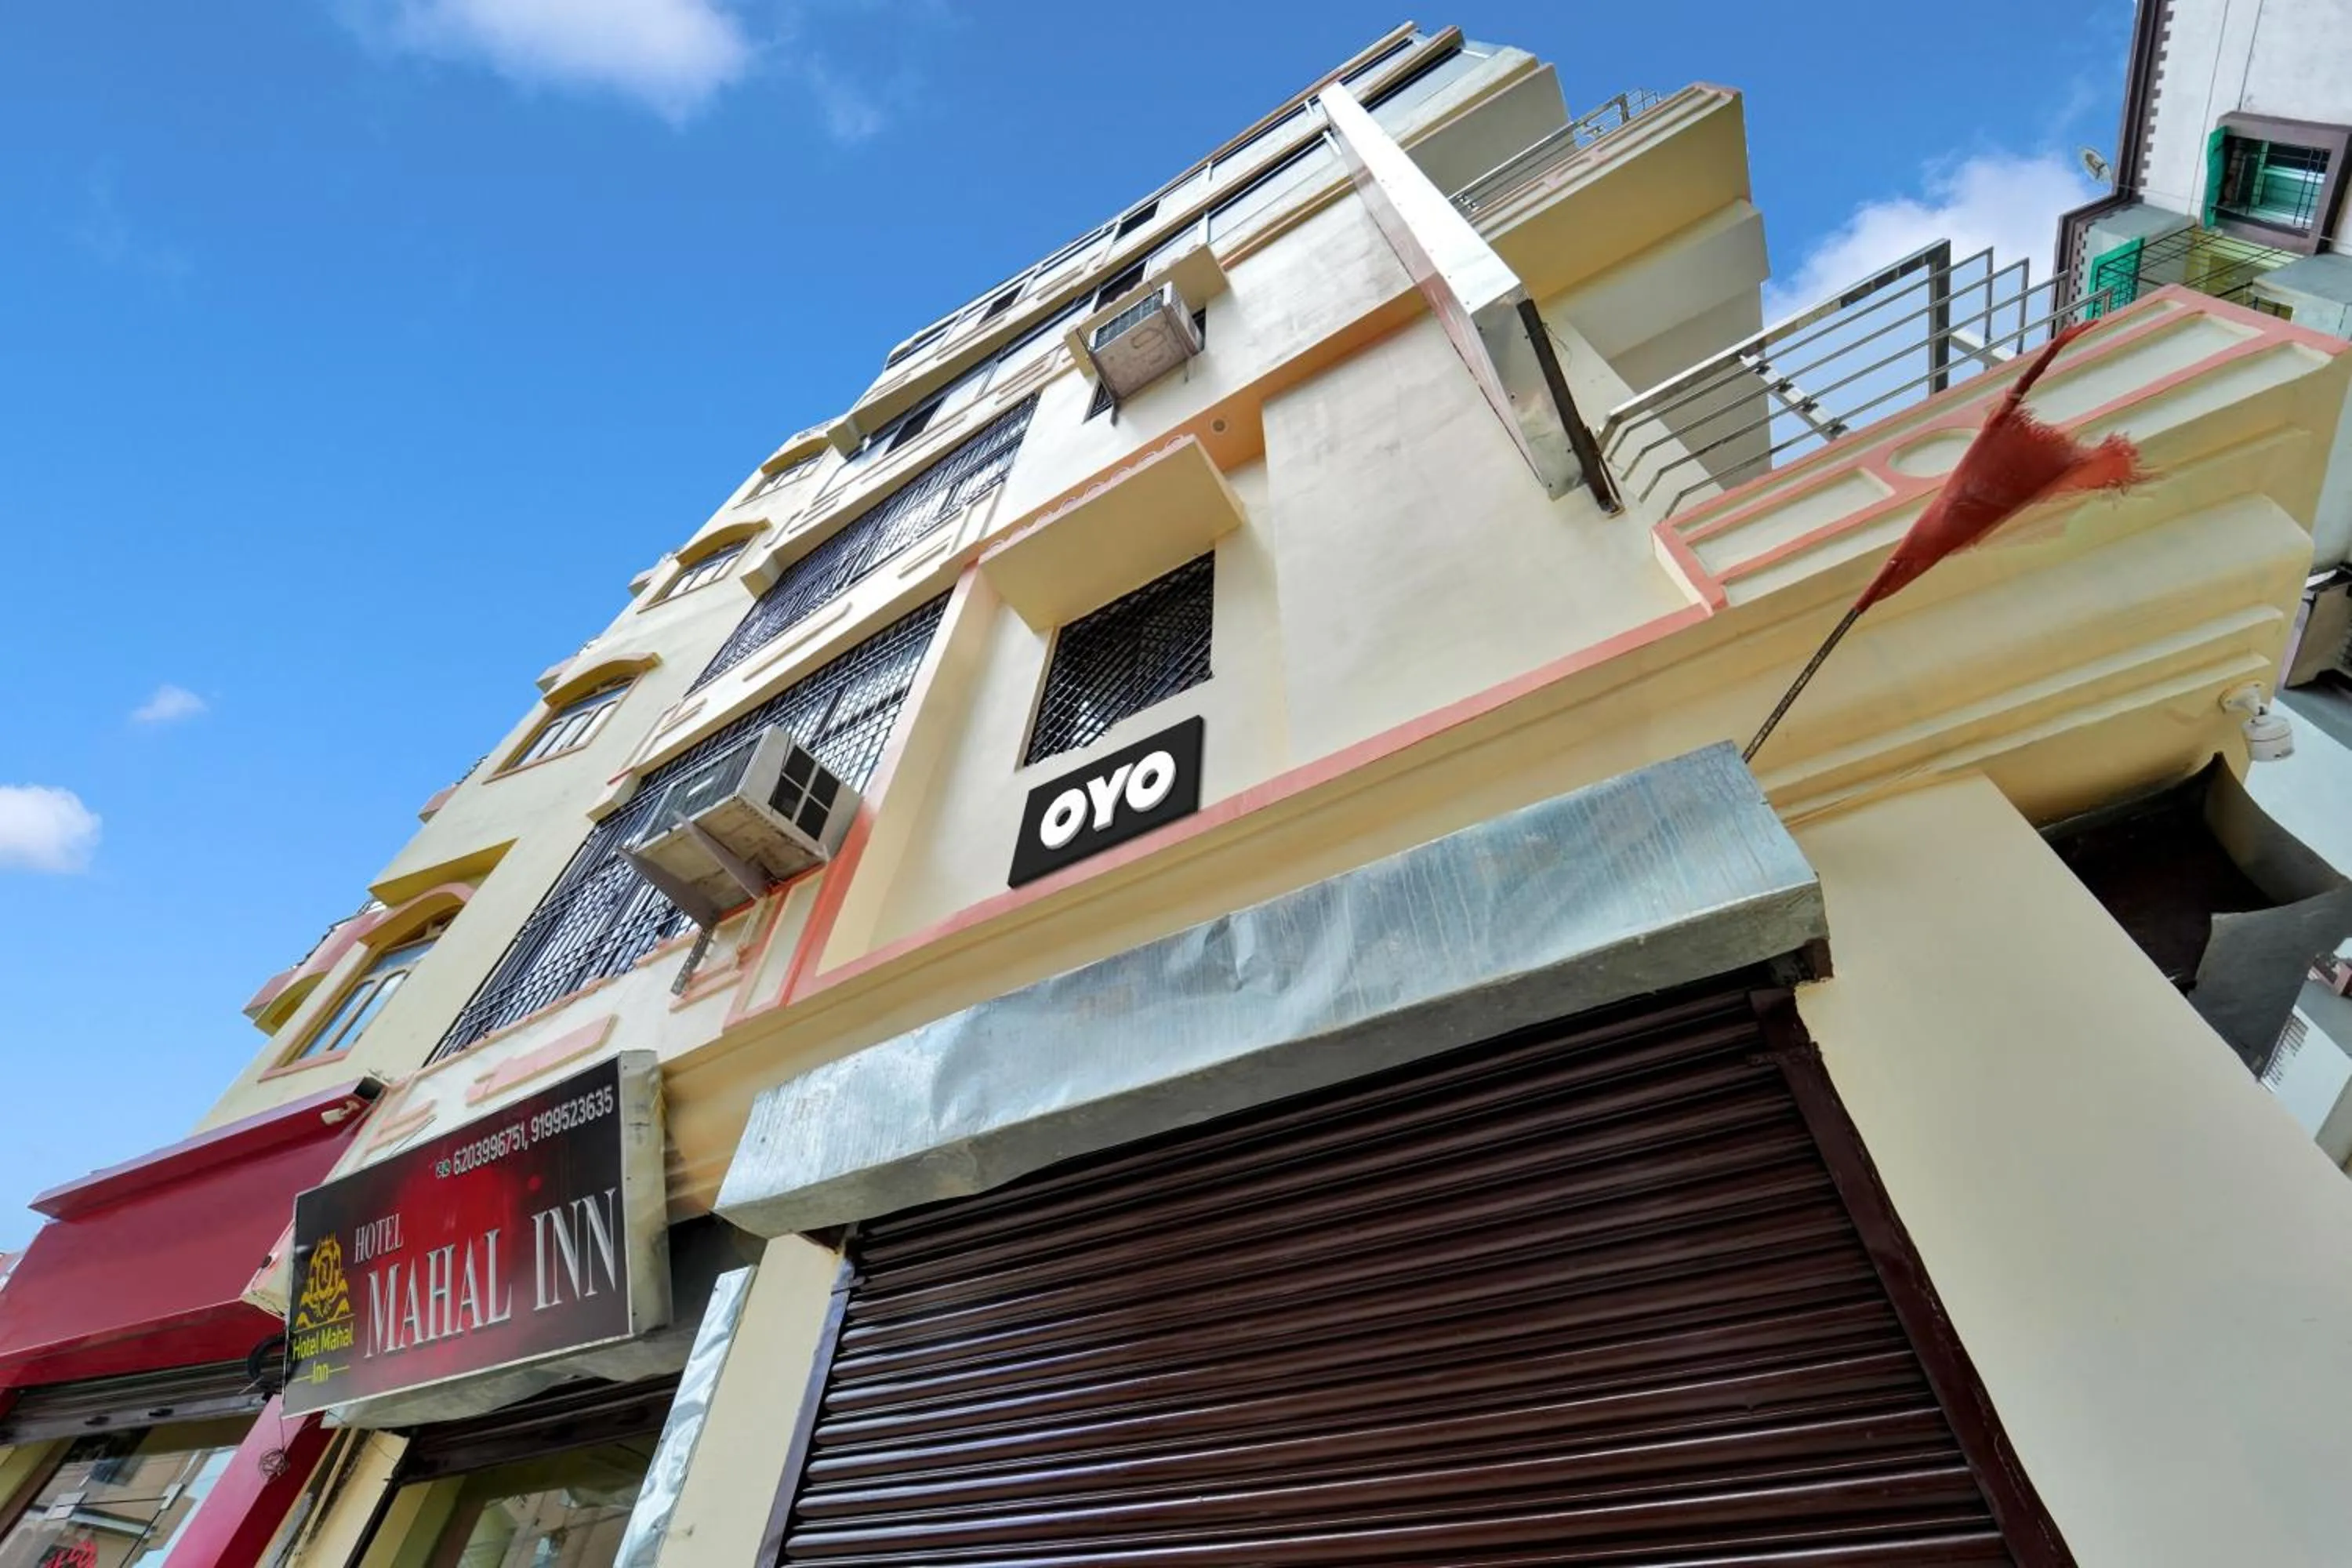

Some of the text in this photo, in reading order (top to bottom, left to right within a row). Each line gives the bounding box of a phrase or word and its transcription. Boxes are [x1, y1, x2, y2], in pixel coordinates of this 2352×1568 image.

[1040, 751, 1176, 849] OYO
[531, 1085, 614, 1143] 9199523635
[354, 1214, 404, 1264] HOTEL
[363, 1188, 618, 1359] MAHAL INN
[292, 1321, 354, 1361] Hotel Mahal
[311, 1362, 329, 1385] Inn
